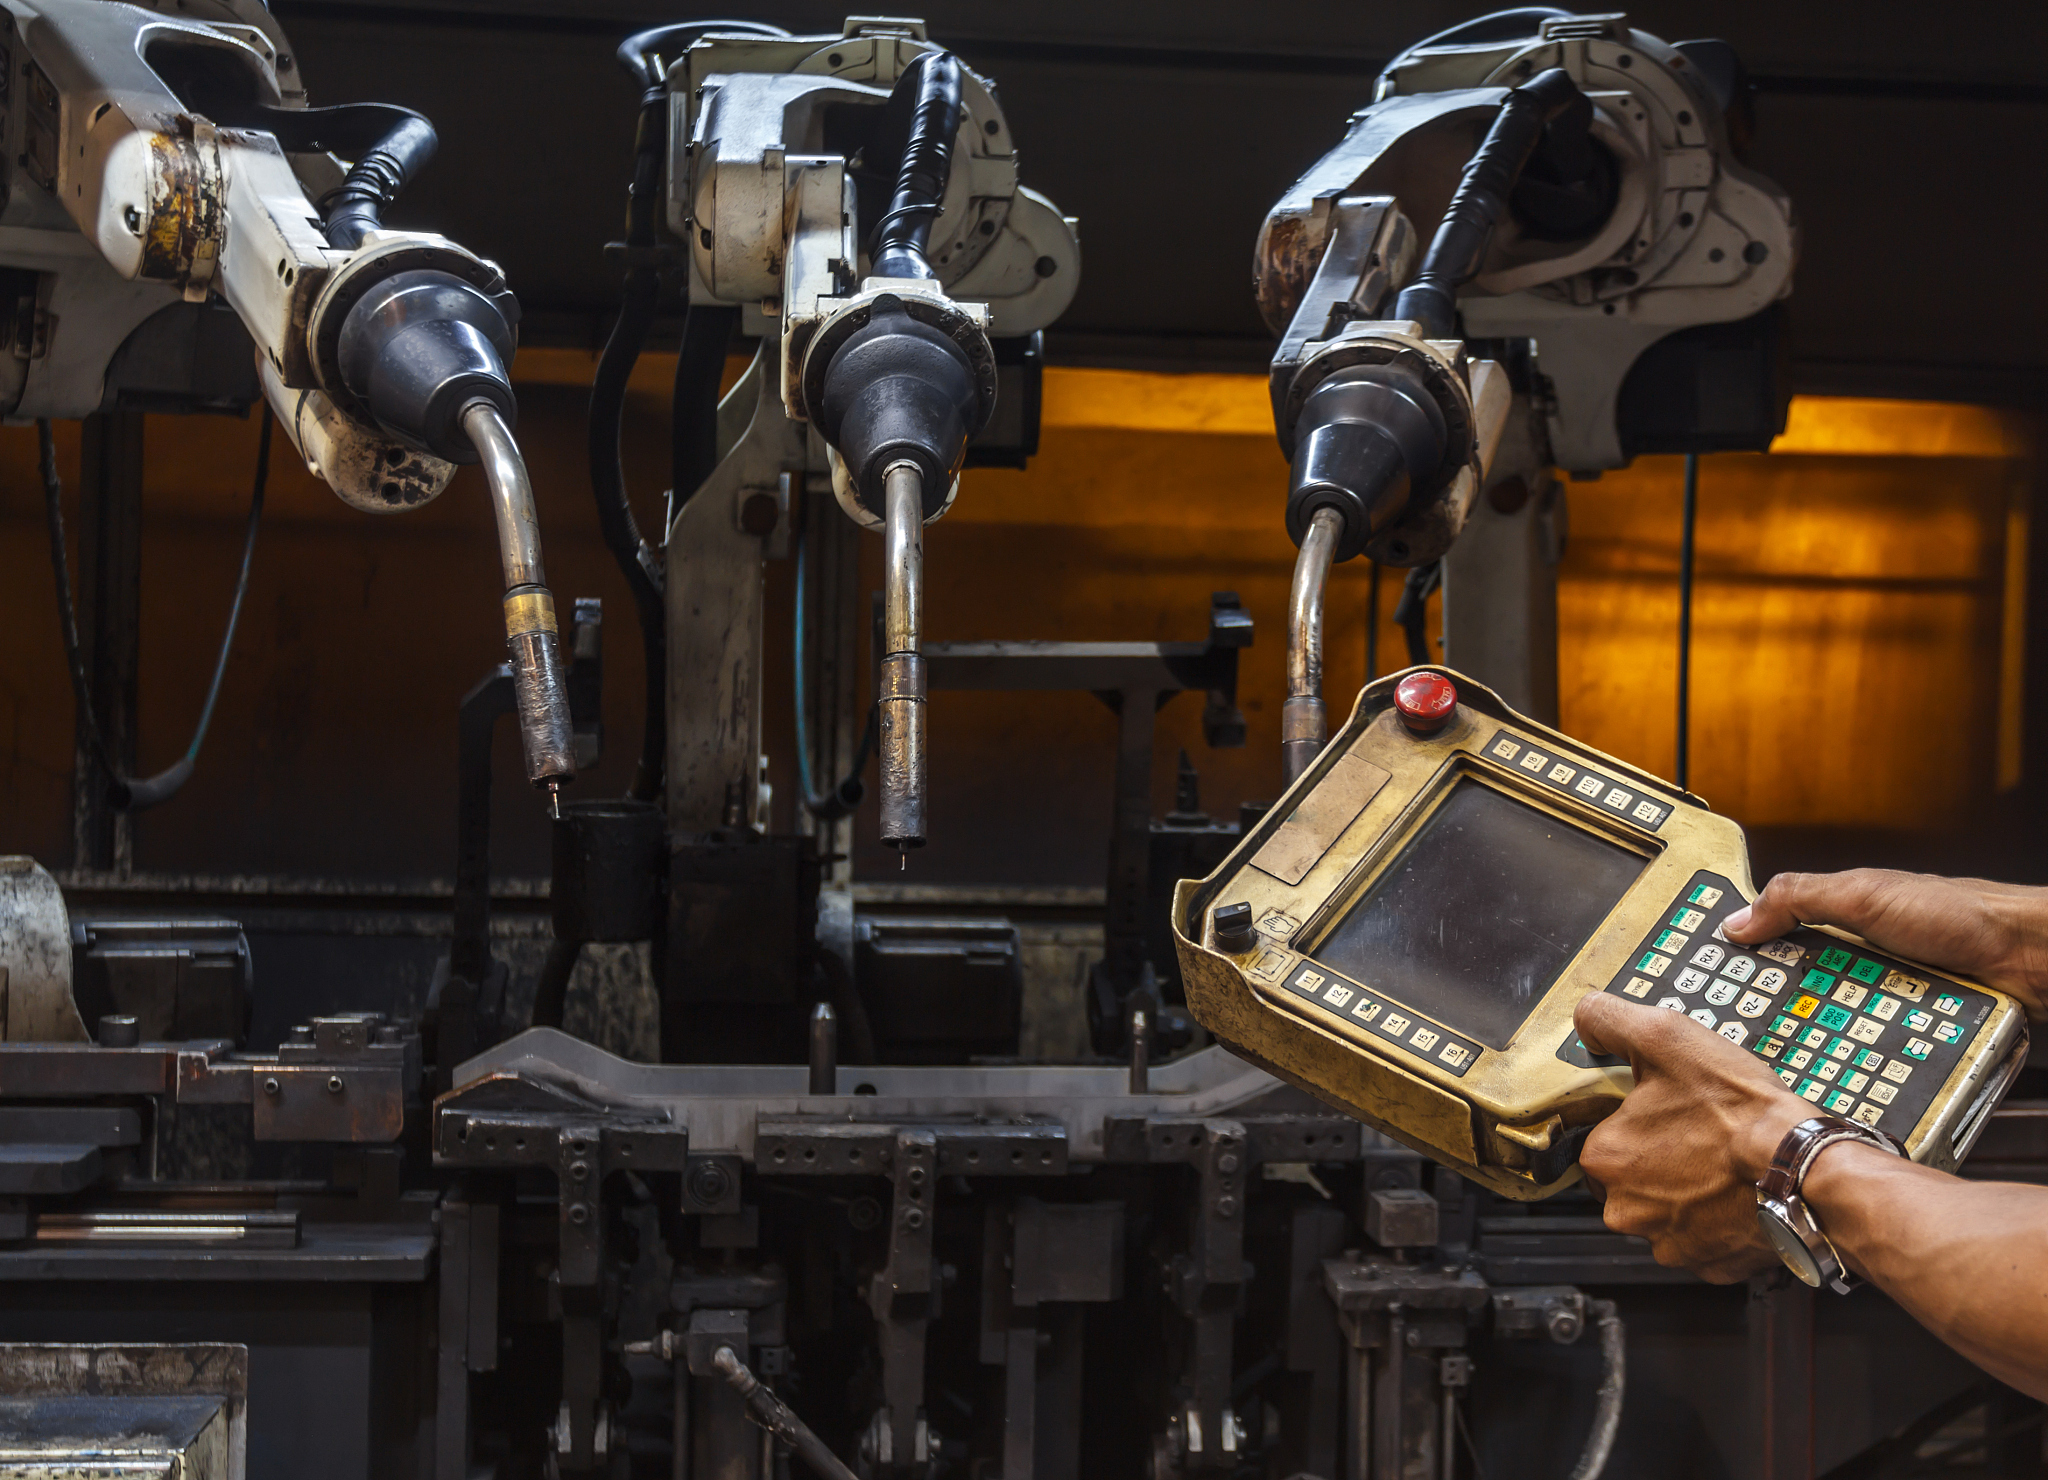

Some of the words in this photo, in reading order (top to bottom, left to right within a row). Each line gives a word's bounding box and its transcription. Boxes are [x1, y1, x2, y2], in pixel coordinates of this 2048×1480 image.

[1500, 744, 1510, 753] f7
[1527, 756, 1538, 765] f8
[1555, 768, 1566, 777] f9
[1581, 780, 1595, 791] f10
[1610, 792, 1623, 804] f11
[1638, 804, 1652, 817] f12
[1675, 911, 1685, 921] STOP
[1769, 940, 1785, 957] CHECK
[1779, 944, 1793, 958] BACK
[1700, 948, 1718, 964] RX+
[1821, 948, 1836, 966] CLAMP
[1832, 954, 1845, 966] ARC
[1731, 959, 1749, 976] RY+
[1860, 965, 1874, 978] DEL
[1303, 975, 1314, 984] f1
[1681, 973, 1697, 989] RX-
[1762, 971, 1781, 988] RZ+
[1813, 975, 1825, 988] INS
[1632, 980, 1644, 994] SYNCH
[1330, 989, 1343, 999] f2
[1712, 985, 1727, 1002] RY-
[1841, 985, 1857, 1002] HELP
[1743, 997, 1760, 1014] RZ-
[1799, 1000, 1813, 1012] REC
[1881, 1002, 1892, 1014] STEP
[1822, 1008, 1836, 1022] MOD
[1832, 1011, 1845, 1025] POS
[1388, 1018, 1399, 1028] f4
[1854, 1020, 1869, 1036] RESET
[1416, 1033, 1428, 1043] f5
[1766, 1042, 1779, 1051] 8
[1837, 1045, 1850, 1053] 3
[1446, 1048, 1458, 1058] f6
[1795, 1054, 1807, 1062] 5
[1813, 1061, 1824, 1070] OFF
[1823, 1066, 1835, 1074] 2
[1837, 1098, 1849, 1107] 0
